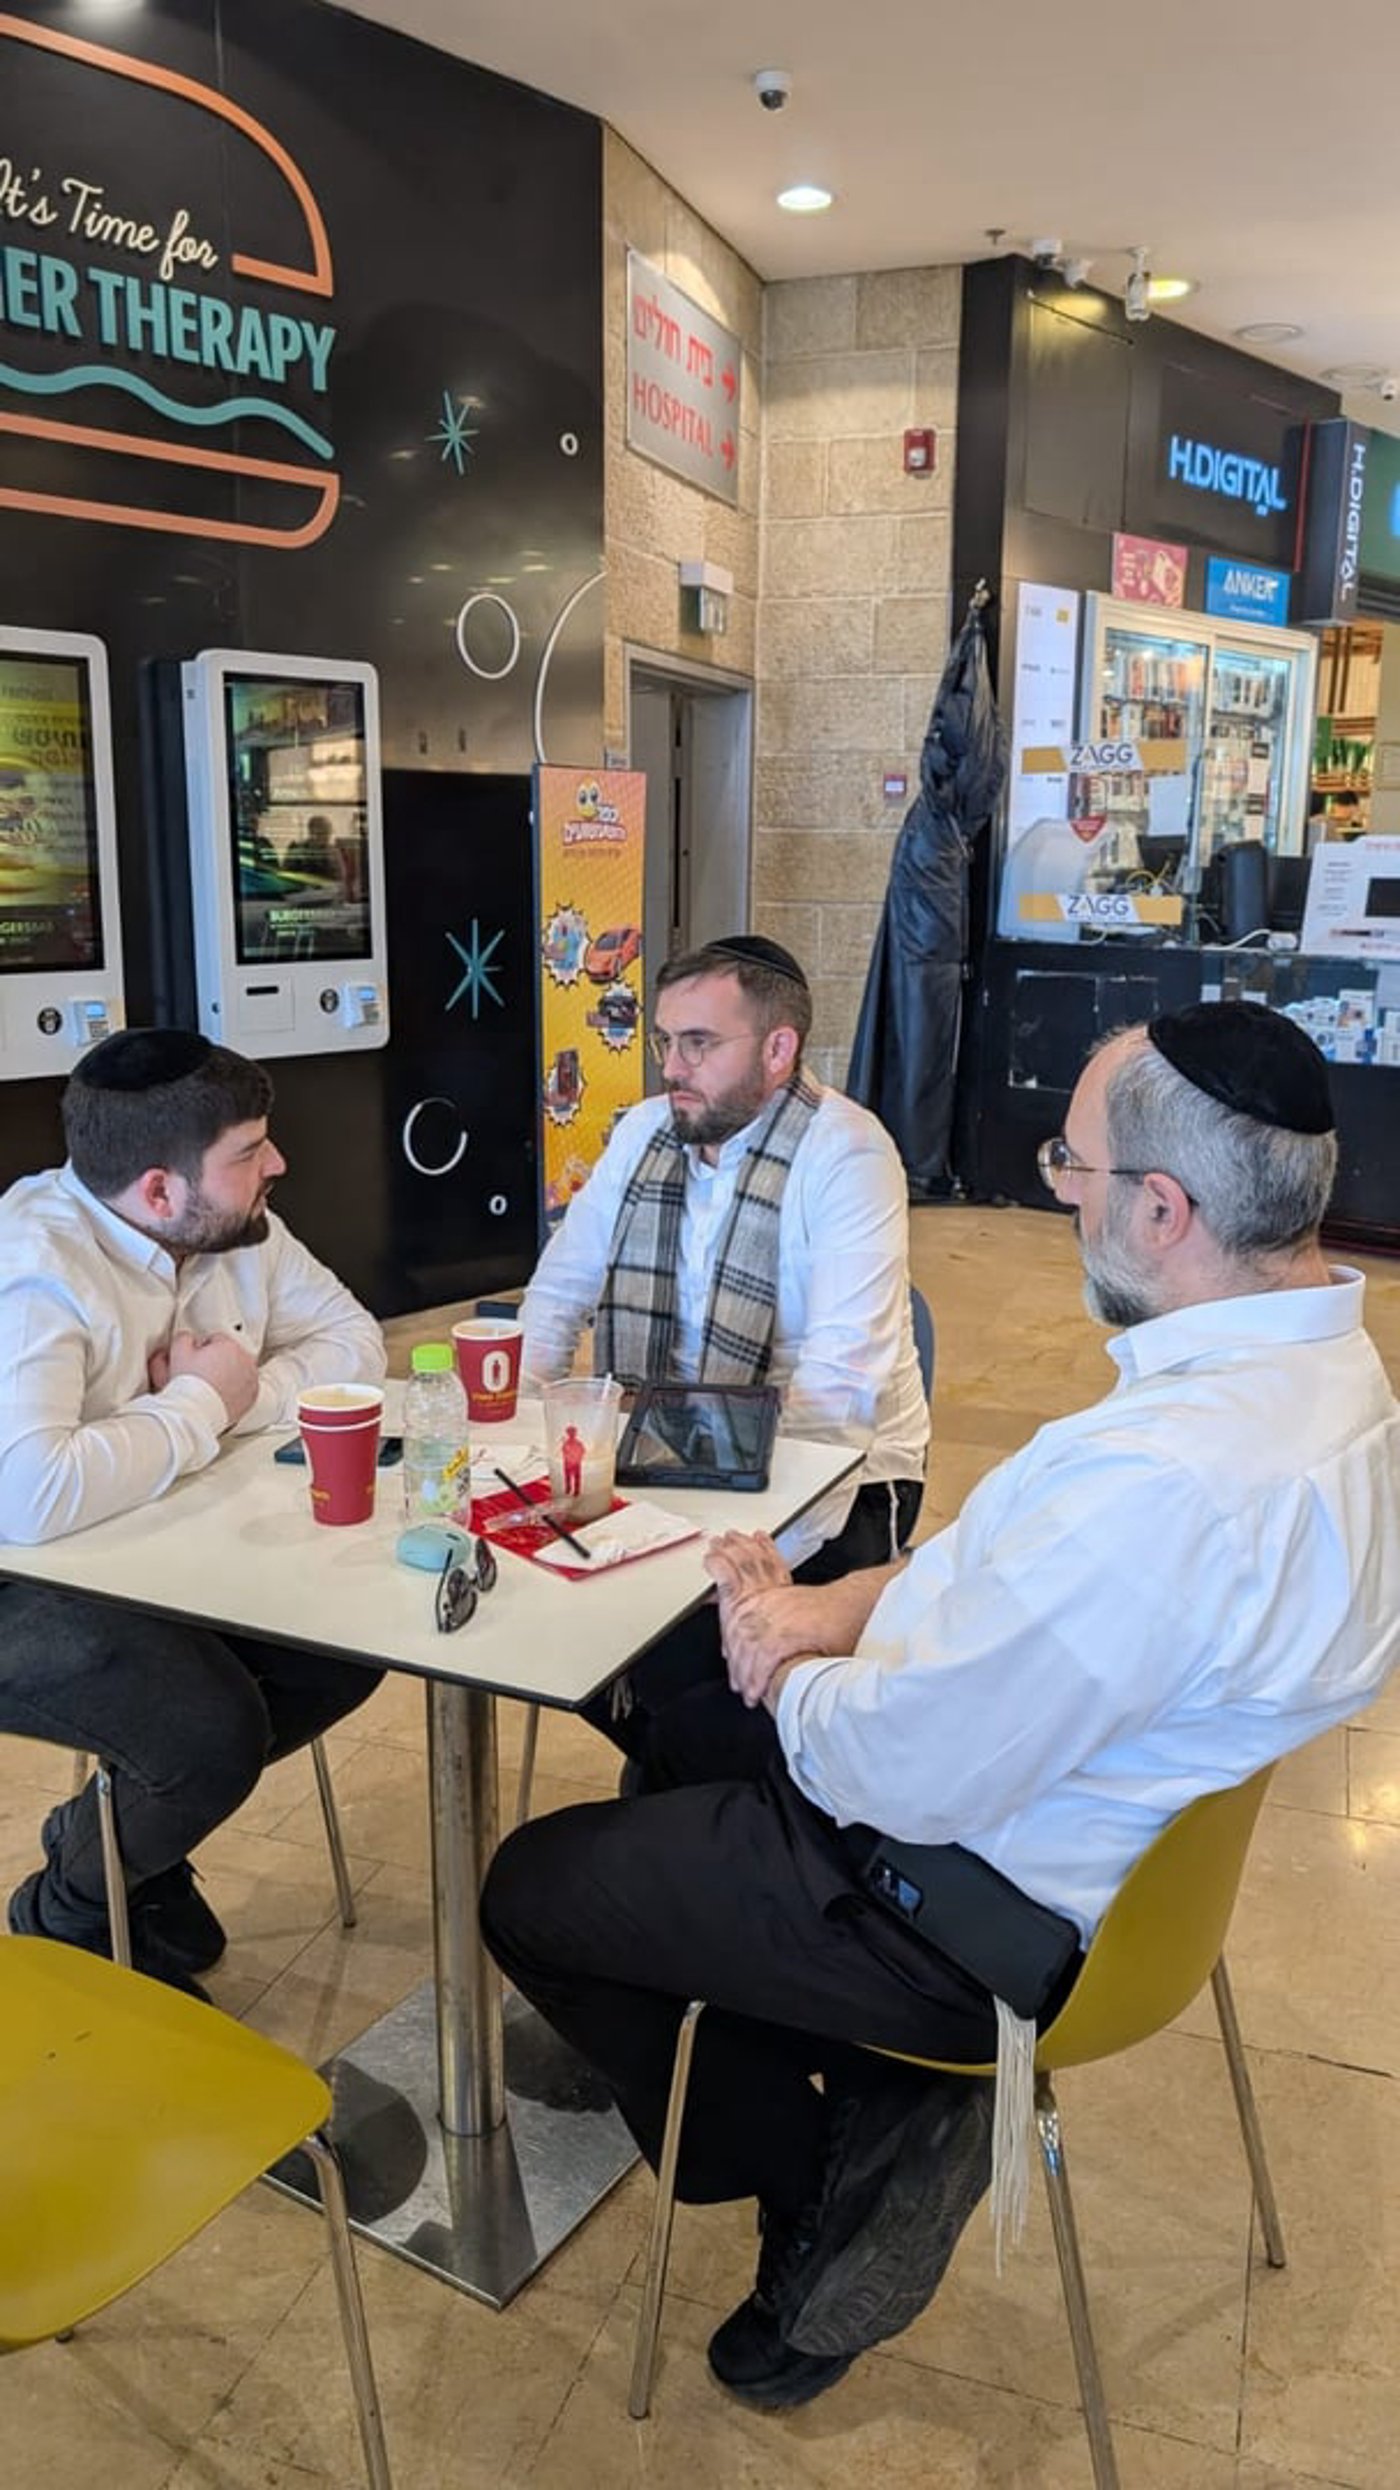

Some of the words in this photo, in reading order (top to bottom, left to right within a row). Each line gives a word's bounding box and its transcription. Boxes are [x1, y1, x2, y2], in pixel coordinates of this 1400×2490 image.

[62, 178, 159, 252] Time
[159, 209, 218, 280] for
[0, 245, 82, 337] ER
[88, 266, 336, 391] THERAPY
[633, 294, 681, 365] חולים
[687, 333, 714, 388] בית
[633, 370, 714, 459] HOSPITAL
[1168, 434, 1287, 517] H.DIGITAL
[1340, 442, 1366, 602] H.DIGITAL
[1223, 568, 1278, 603] ANKER
[1071, 743, 1134, 766] ZAGG
[1067, 894, 1129, 916] ZAGG
